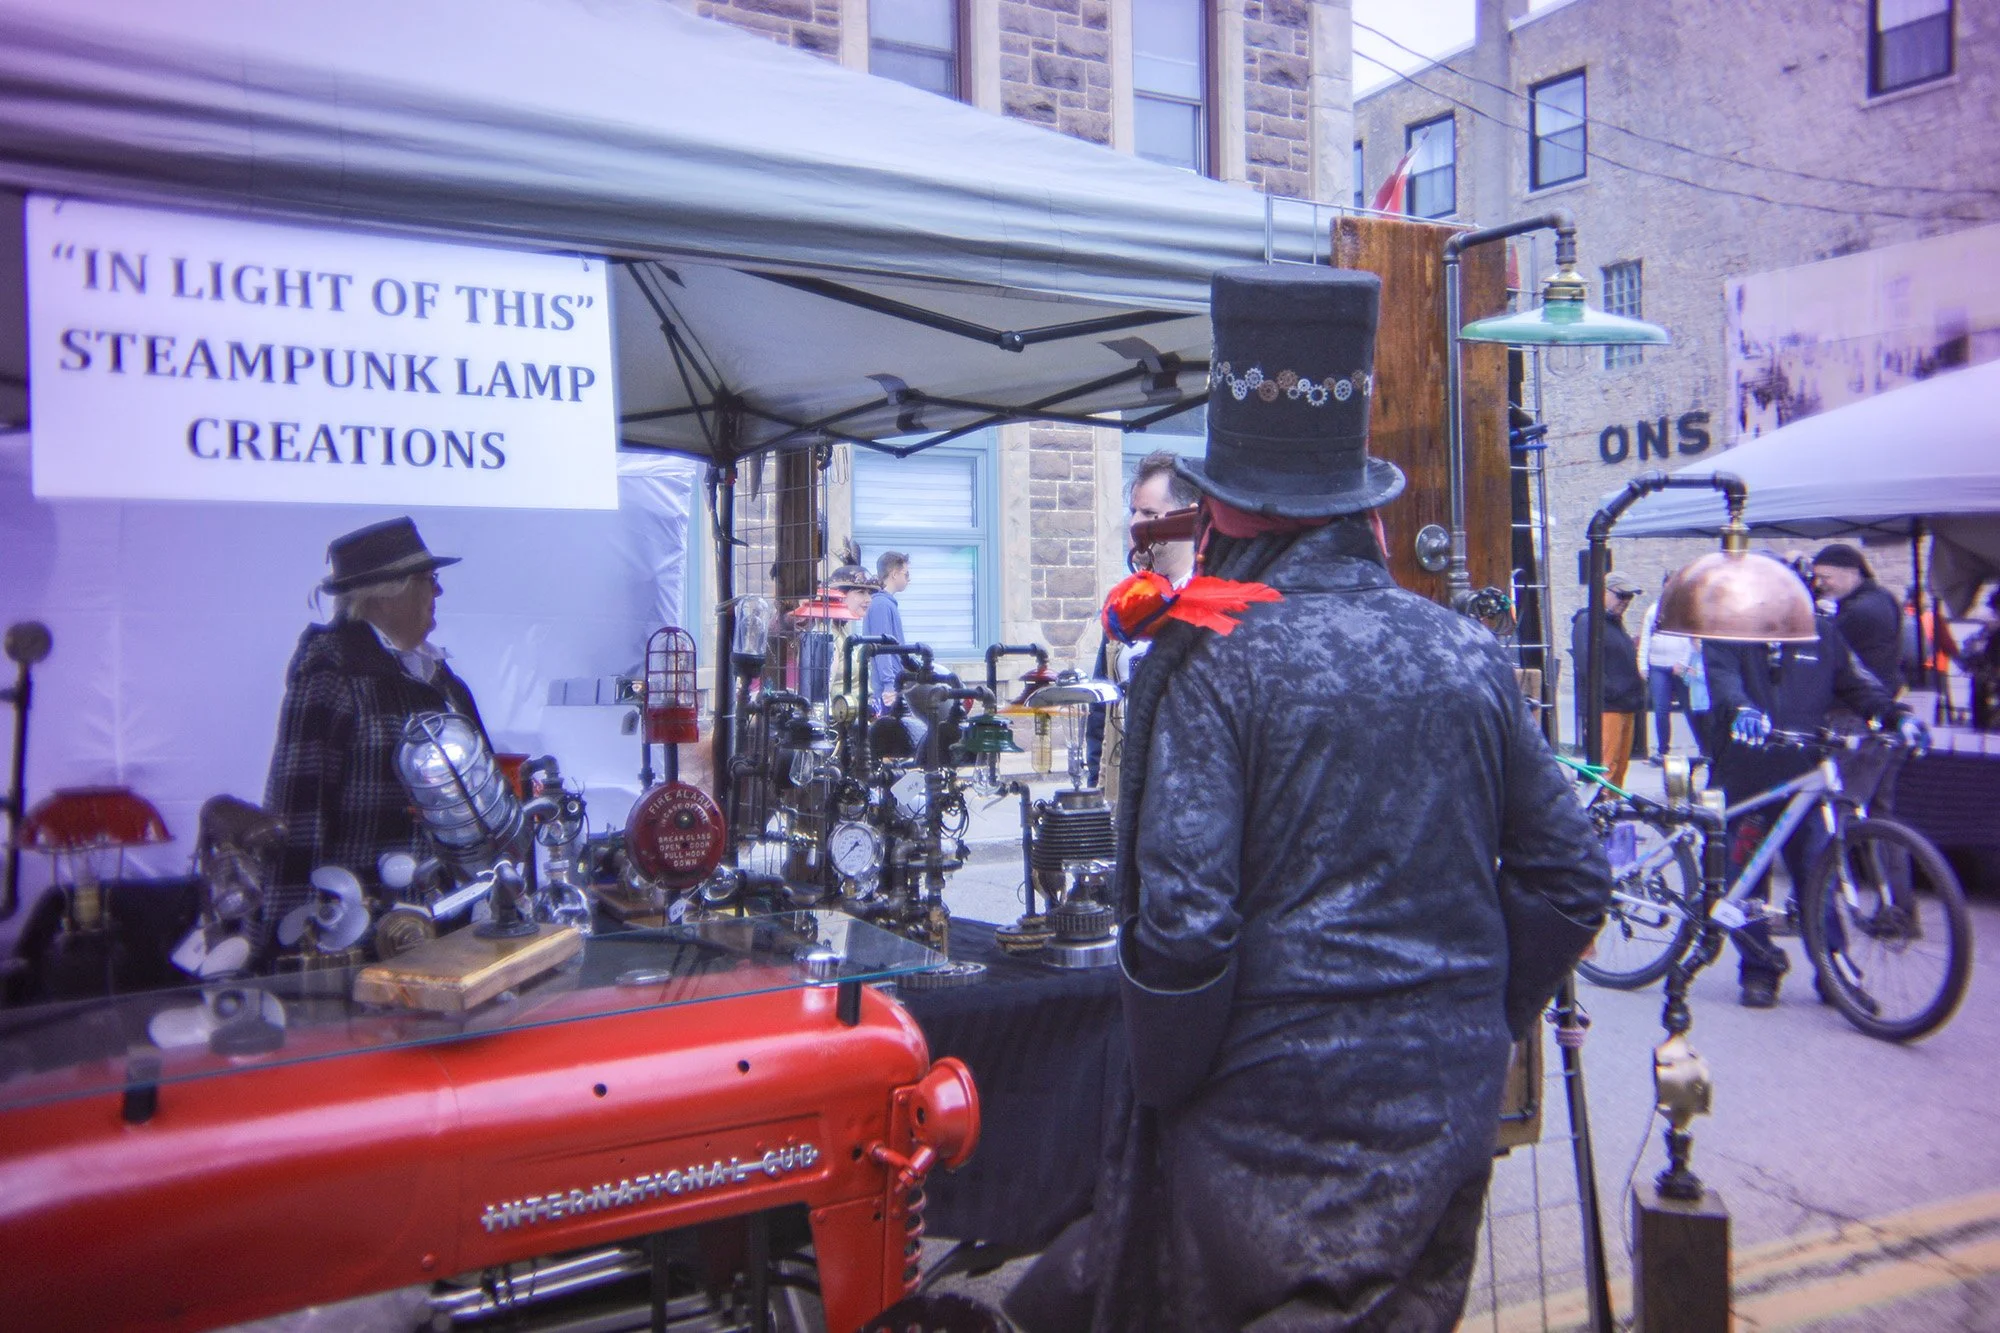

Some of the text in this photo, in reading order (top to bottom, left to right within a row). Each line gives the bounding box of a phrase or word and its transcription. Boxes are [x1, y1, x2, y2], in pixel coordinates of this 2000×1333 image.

[52, 243, 595, 332] “IN LIGHT OF THIS”
[59, 328, 597, 403] STEAMPUNK LAMP
[186, 416, 507, 471] CREATIONS
[1600, 411, 1711, 464] ONS
[648, 790, 713, 815] FIRE ALARM
[663, 803, 683, 819] CASE
[658, 832, 711, 843] BREAK GLASS
[659, 843, 681, 851] OPEN
[664, 851, 683, 859] PULL
[673, 859, 697, 867] DOWN
[481, 1143, 817, 1233] INTERNATIONAL CUB
